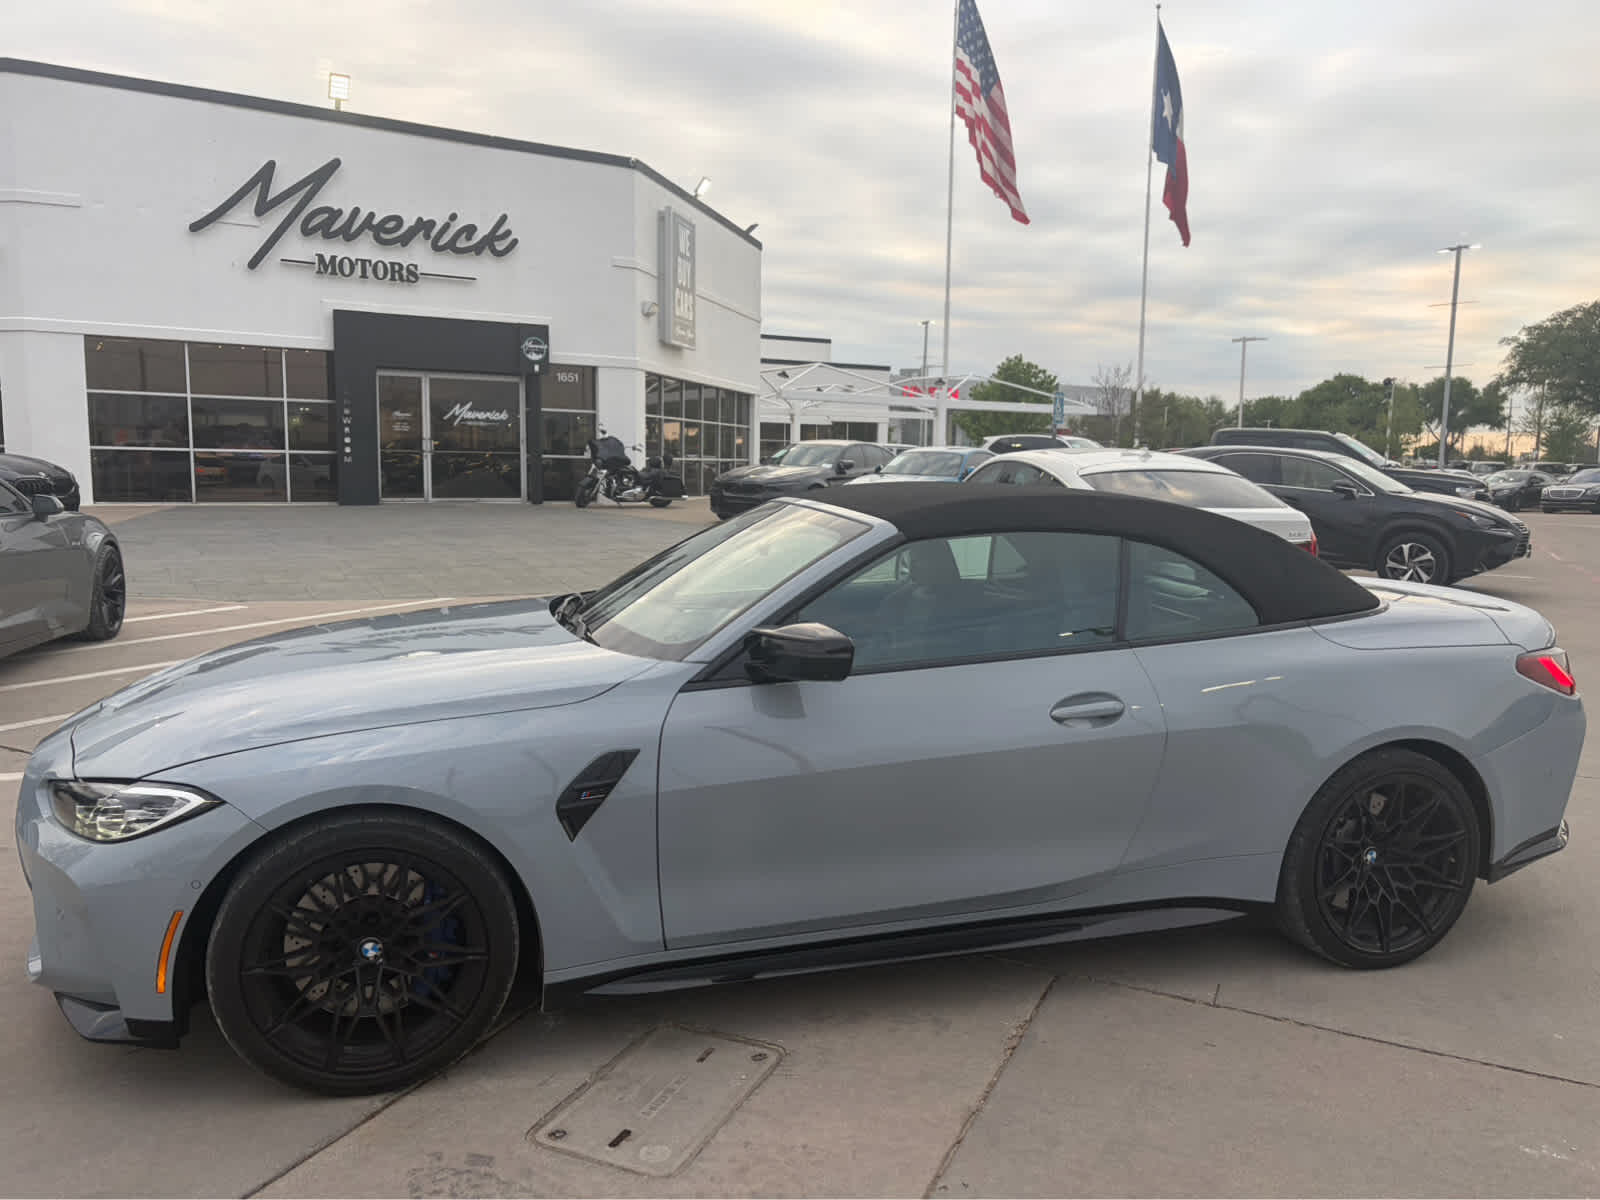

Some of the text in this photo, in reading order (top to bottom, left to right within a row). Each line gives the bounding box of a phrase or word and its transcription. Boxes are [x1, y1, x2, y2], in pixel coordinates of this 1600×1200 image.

[188, 157, 519, 270] Maverick
[314, 253, 420, 284] MOTORS
[556, 371, 579, 384] 1651
[443, 401, 510, 427] Maverick
